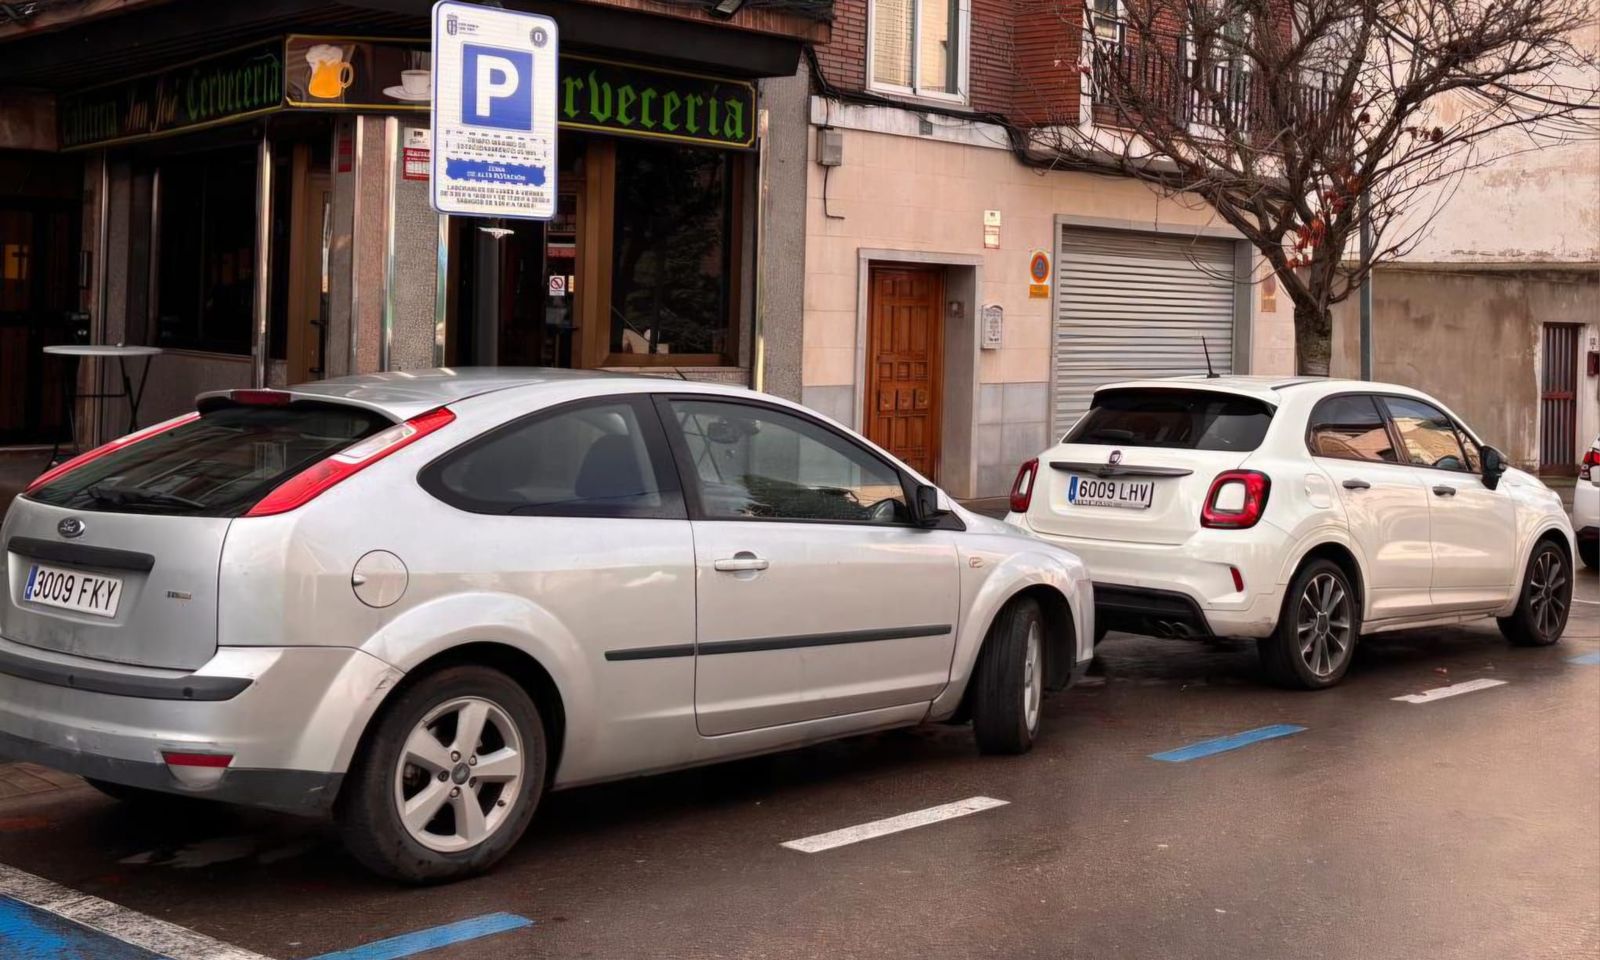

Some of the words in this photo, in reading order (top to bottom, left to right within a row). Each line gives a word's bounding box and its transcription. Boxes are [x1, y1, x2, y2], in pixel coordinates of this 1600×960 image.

[476, 54, 519, 117] P
[562, 69, 745, 139] rvecería
[1080, 480, 1115, 499] 6009
[1119, 483, 1148, 501] LHV
[33, 570, 75, 603] 3009
[77, 578, 118, 610] FKY
